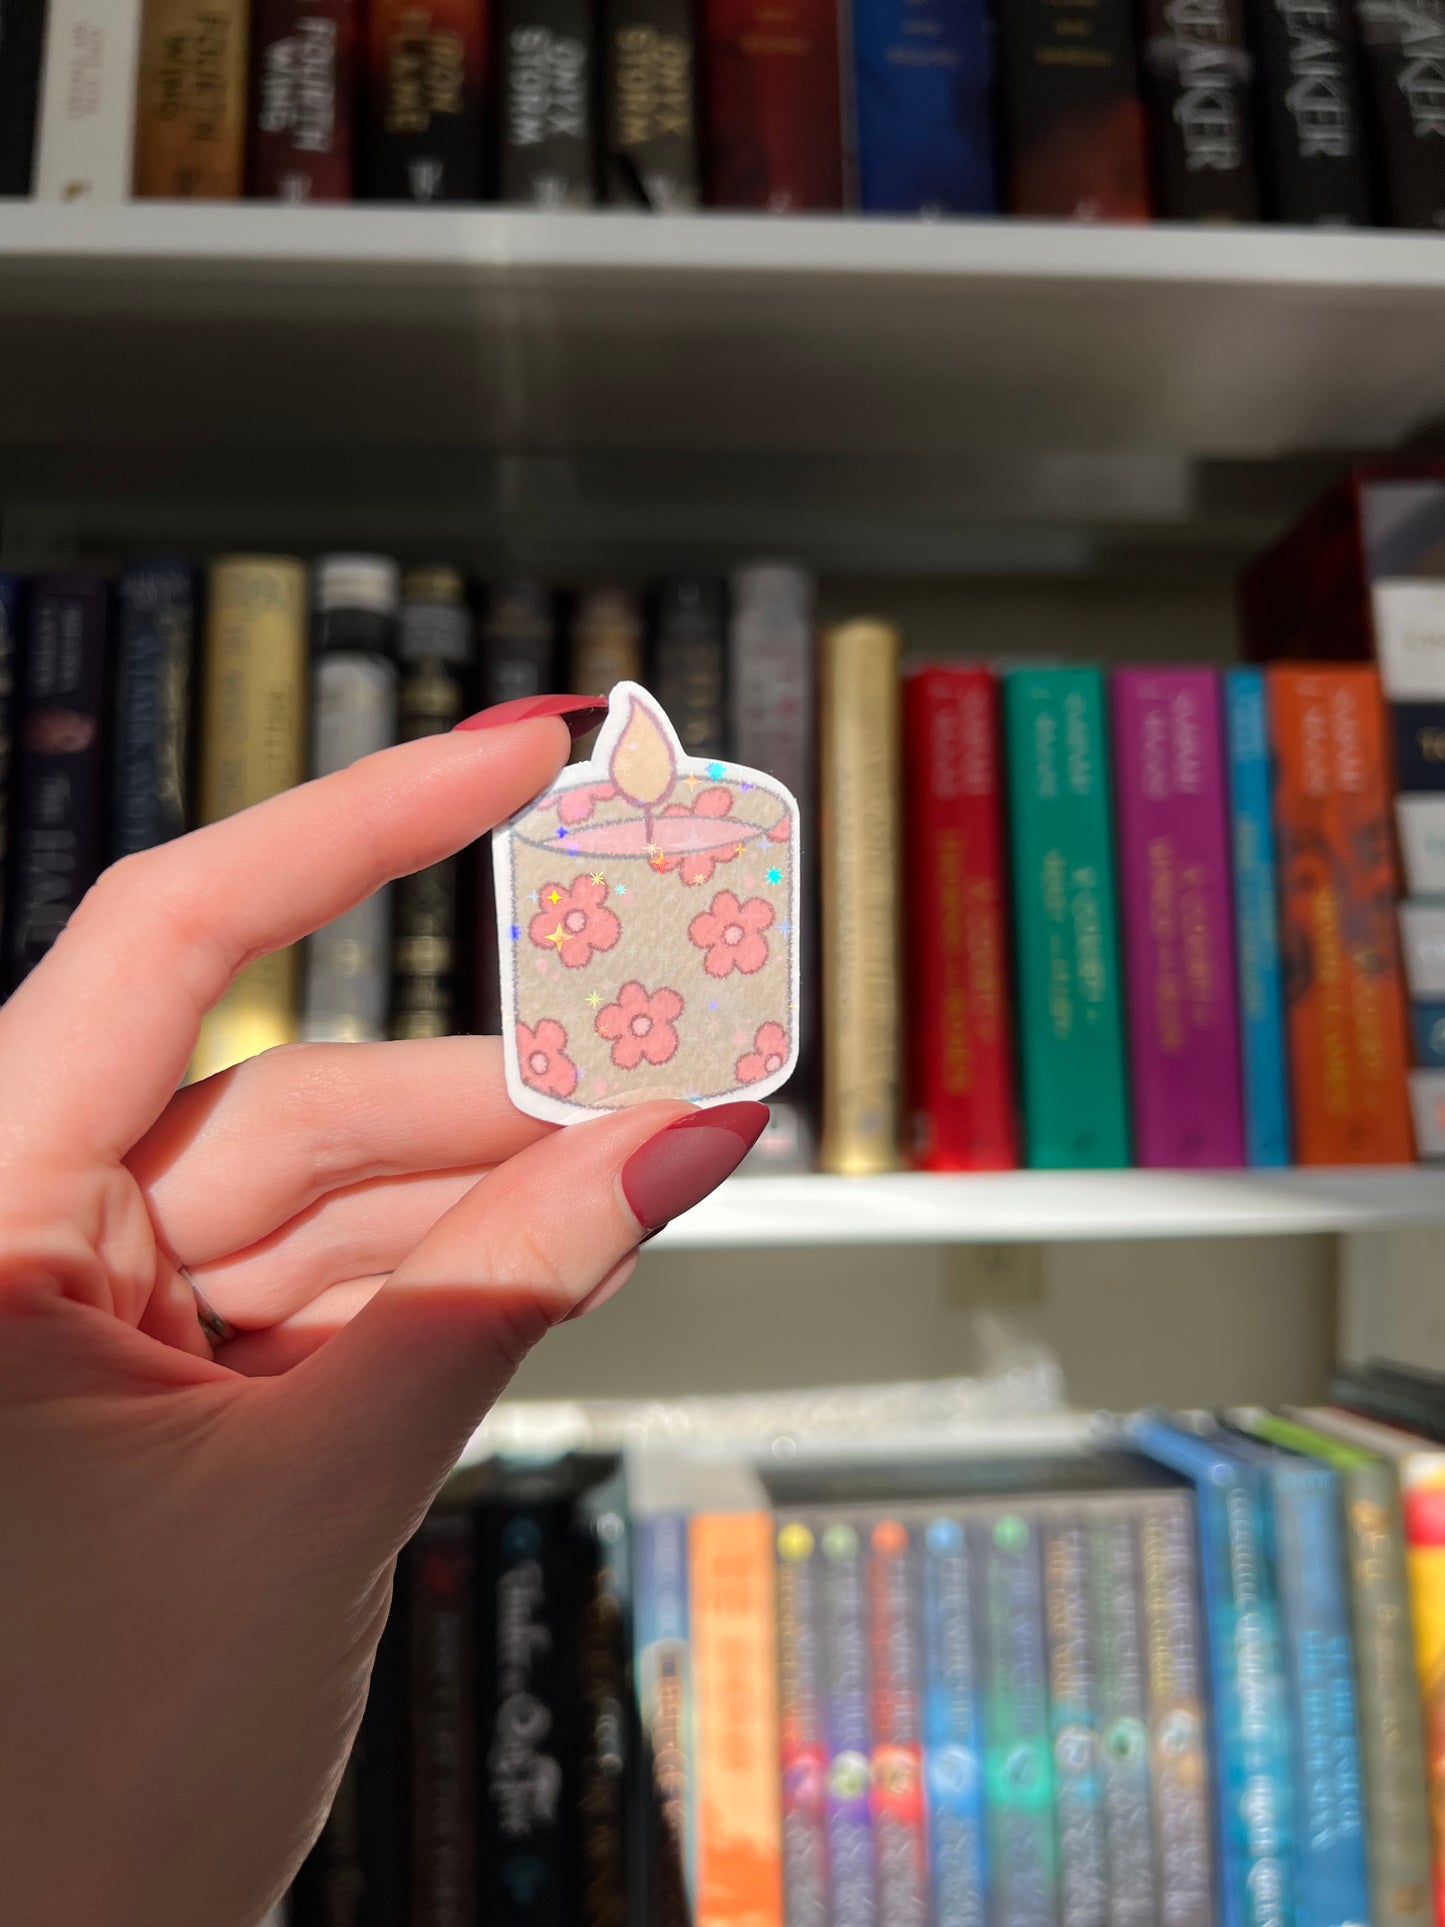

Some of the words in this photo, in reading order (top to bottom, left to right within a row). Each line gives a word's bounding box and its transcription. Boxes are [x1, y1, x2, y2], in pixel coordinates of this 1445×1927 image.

[259, 37, 298, 133] WING
[295, 17, 338, 152] FOURTH
[509, 26, 549, 146] STORM
[547, 38, 588, 139] ONYX
[614, 26, 653, 146] STORM
[651, 38, 692, 137] ONYX
